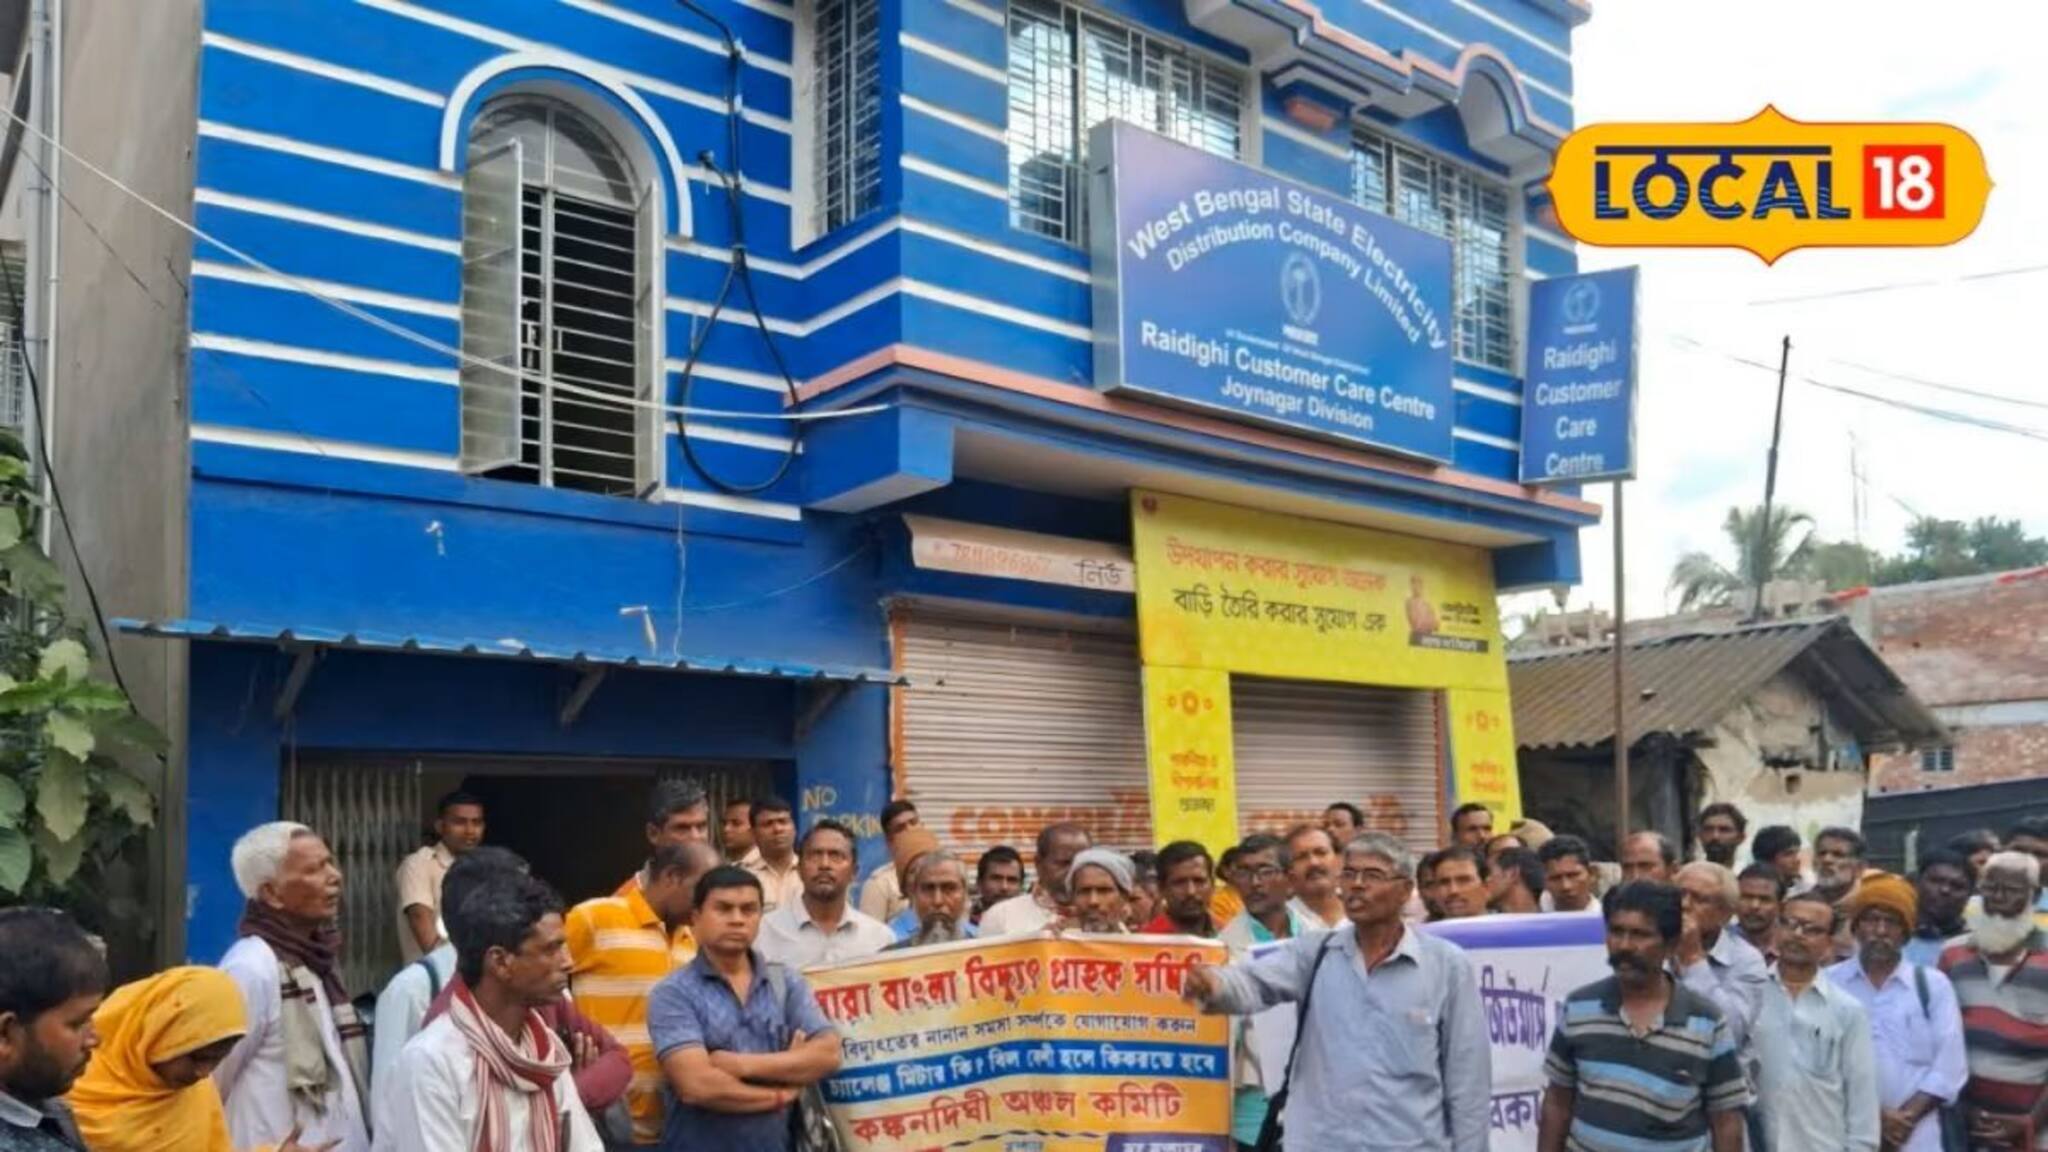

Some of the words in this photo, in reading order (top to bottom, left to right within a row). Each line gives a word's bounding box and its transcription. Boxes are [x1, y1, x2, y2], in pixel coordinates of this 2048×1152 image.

[1127, 201, 1193, 260] West
[1194, 187, 1280, 218] Bengal
[1287, 189, 1346, 236] State
[1351, 223, 1447, 349] Electricity
[1166, 221, 1275, 272] Distribution
[1278, 221, 1362, 279] Company
[1364, 268, 1420, 343] Limited
[1140, 320, 1230, 367] Raidighi
[1235, 346, 1330, 392] Customer
[1334, 373, 1376, 405] Care
[1380, 386, 1436, 420] Centre
[1543, 338, 1617, 370] Raidighi
[1220, 375, 1303, 414] Joynagar
[1307, 394, 1374, 431] Division
[1535, 378, 1625, 407] Customer
[1556, 415, 1598, 440] Care
[1545, 451, 1605, 476] Centre
[1172, 583, 1213, 617] বাড়ি
[1219, 583, 1259, 619] তৈরি
[1263, 600, 1309, 625] করার
[1312, 606, 1357, 634] সুযোগ
[1362, 613, 1387, 632] এক
[802, 785, 837, 812] NO
[878, 970, 958, 1012] বাংলা
[965, 954, 1040, 1004] বিদ্যুৎ
[1050, 957, 1123, 993] গ্রাহক
[1133, 951, 1203, 995] সমি
[925, 1024, 969, 1048] নানান
[1074, 1013, 1149, 1032] যোগাযোগ
[1059, 1048, 1096, 1070] হলে
[1178, 1052, 1217, 1074] হবে
[1001, 1088, 1076, 1119] অঞ্চল
[1088, 1080, 1184, 1119] কমিটি
